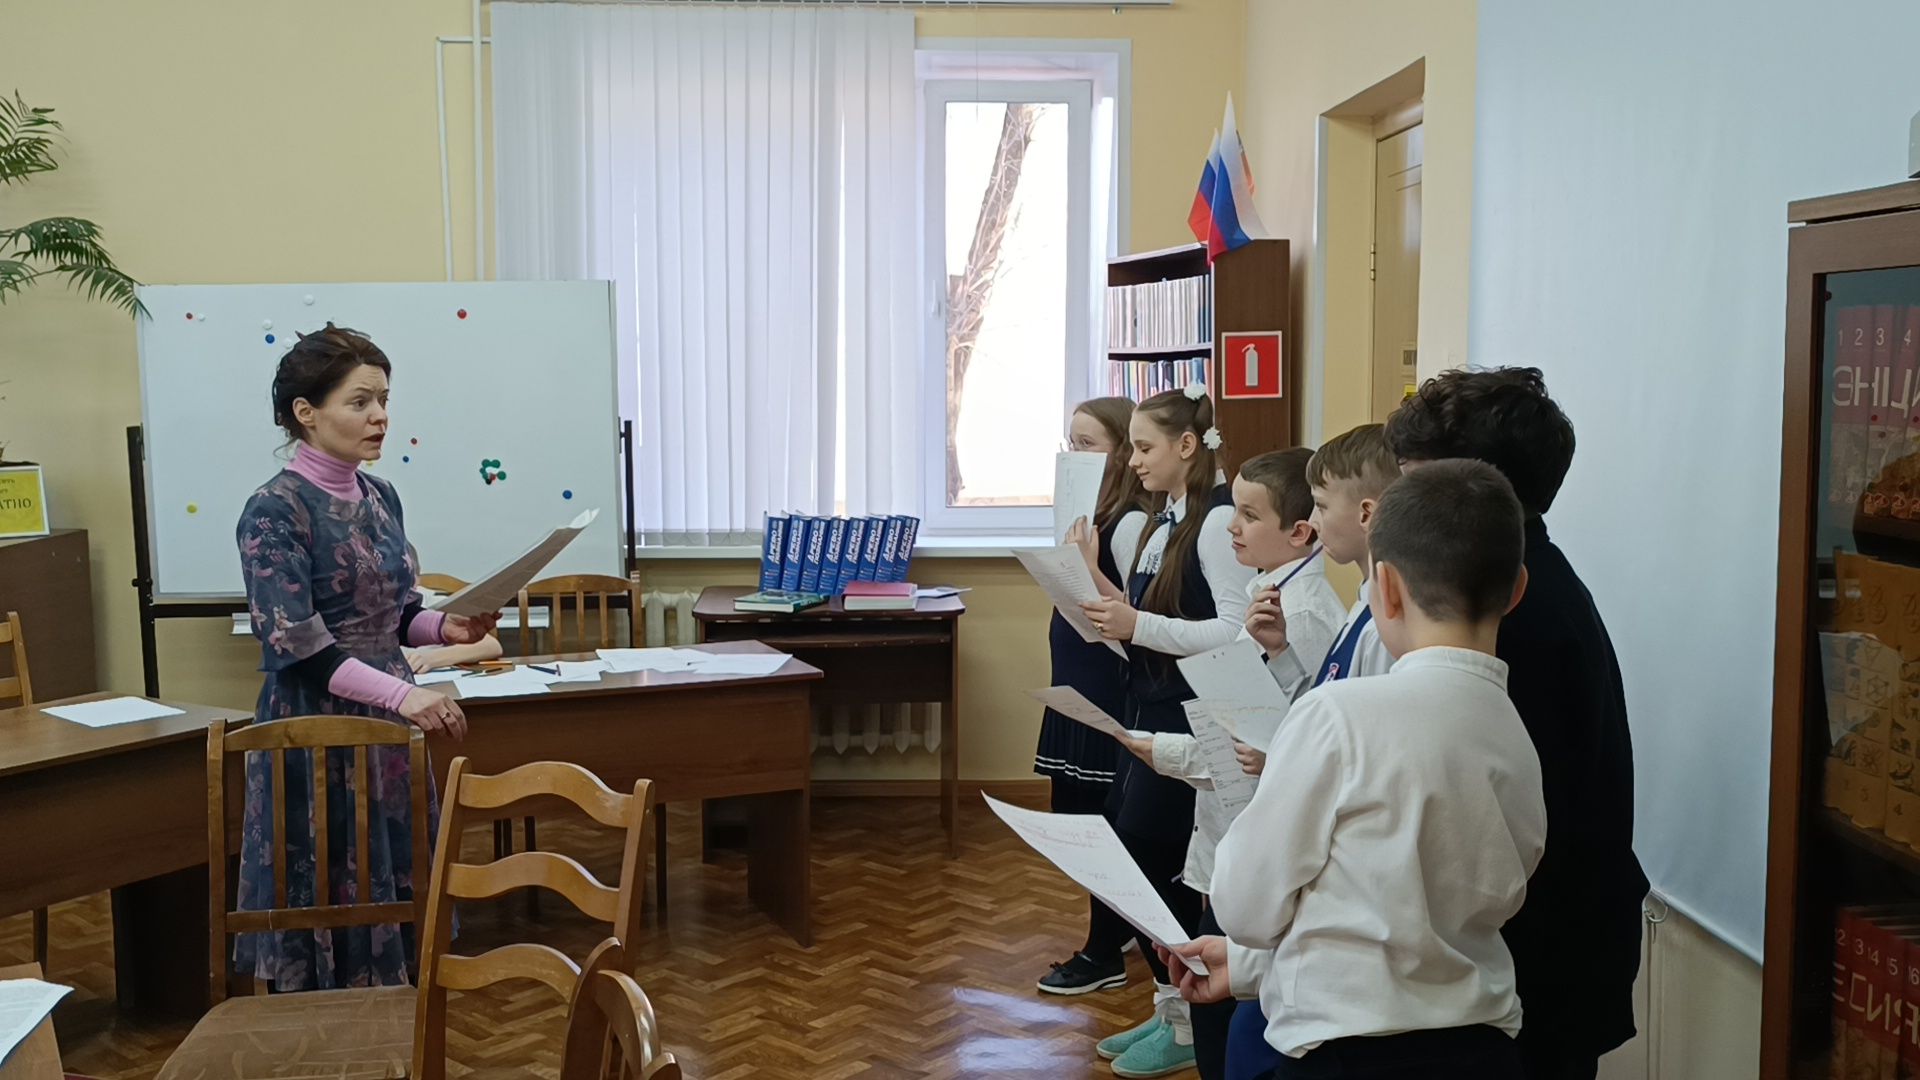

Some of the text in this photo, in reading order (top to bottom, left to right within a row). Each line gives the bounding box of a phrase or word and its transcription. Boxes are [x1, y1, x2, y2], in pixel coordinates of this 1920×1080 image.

[1854, 328, 1864, 346] 2
[1875, 327, 1885, 346] 3
[1903, 328, 1912, 345] 4
